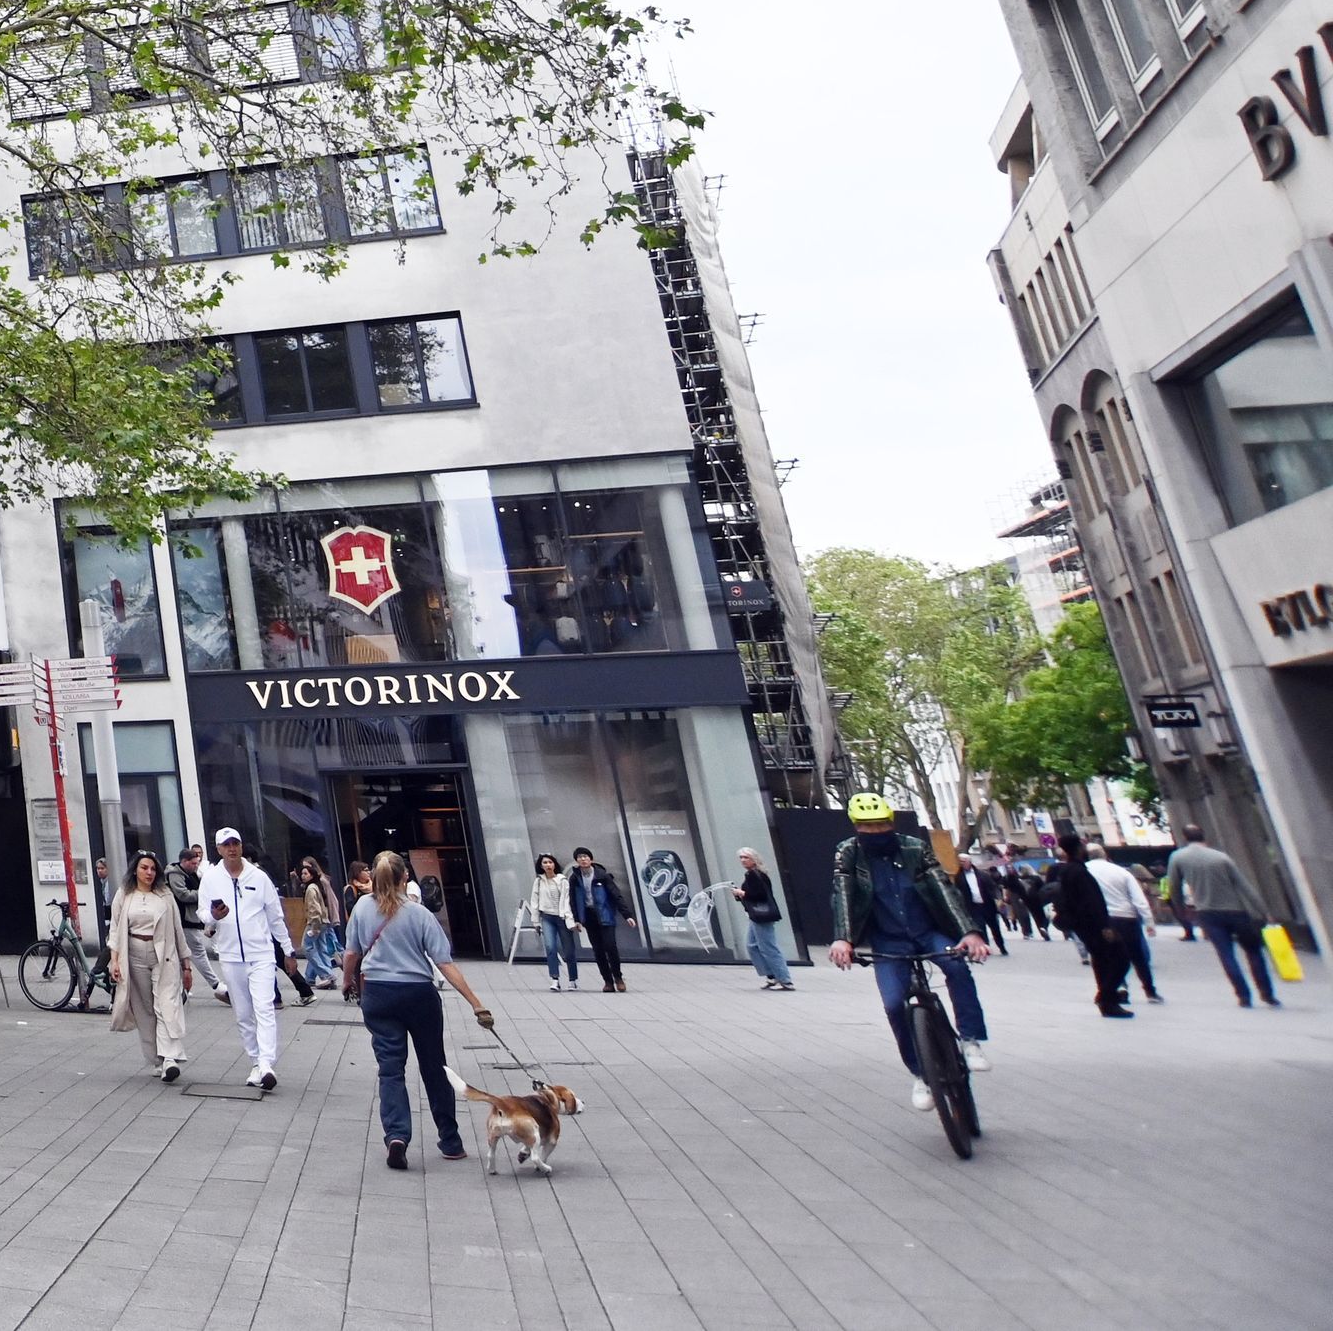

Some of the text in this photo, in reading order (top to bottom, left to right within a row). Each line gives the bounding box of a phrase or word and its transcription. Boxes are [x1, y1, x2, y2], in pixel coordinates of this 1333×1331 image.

[1236, 21, 1333, 181] BV
[727, 598, 765, 606] TORINOX
[245, 670, 521, 710] VICTORINOX
[1151, 709, 1196, 721] TUMI
